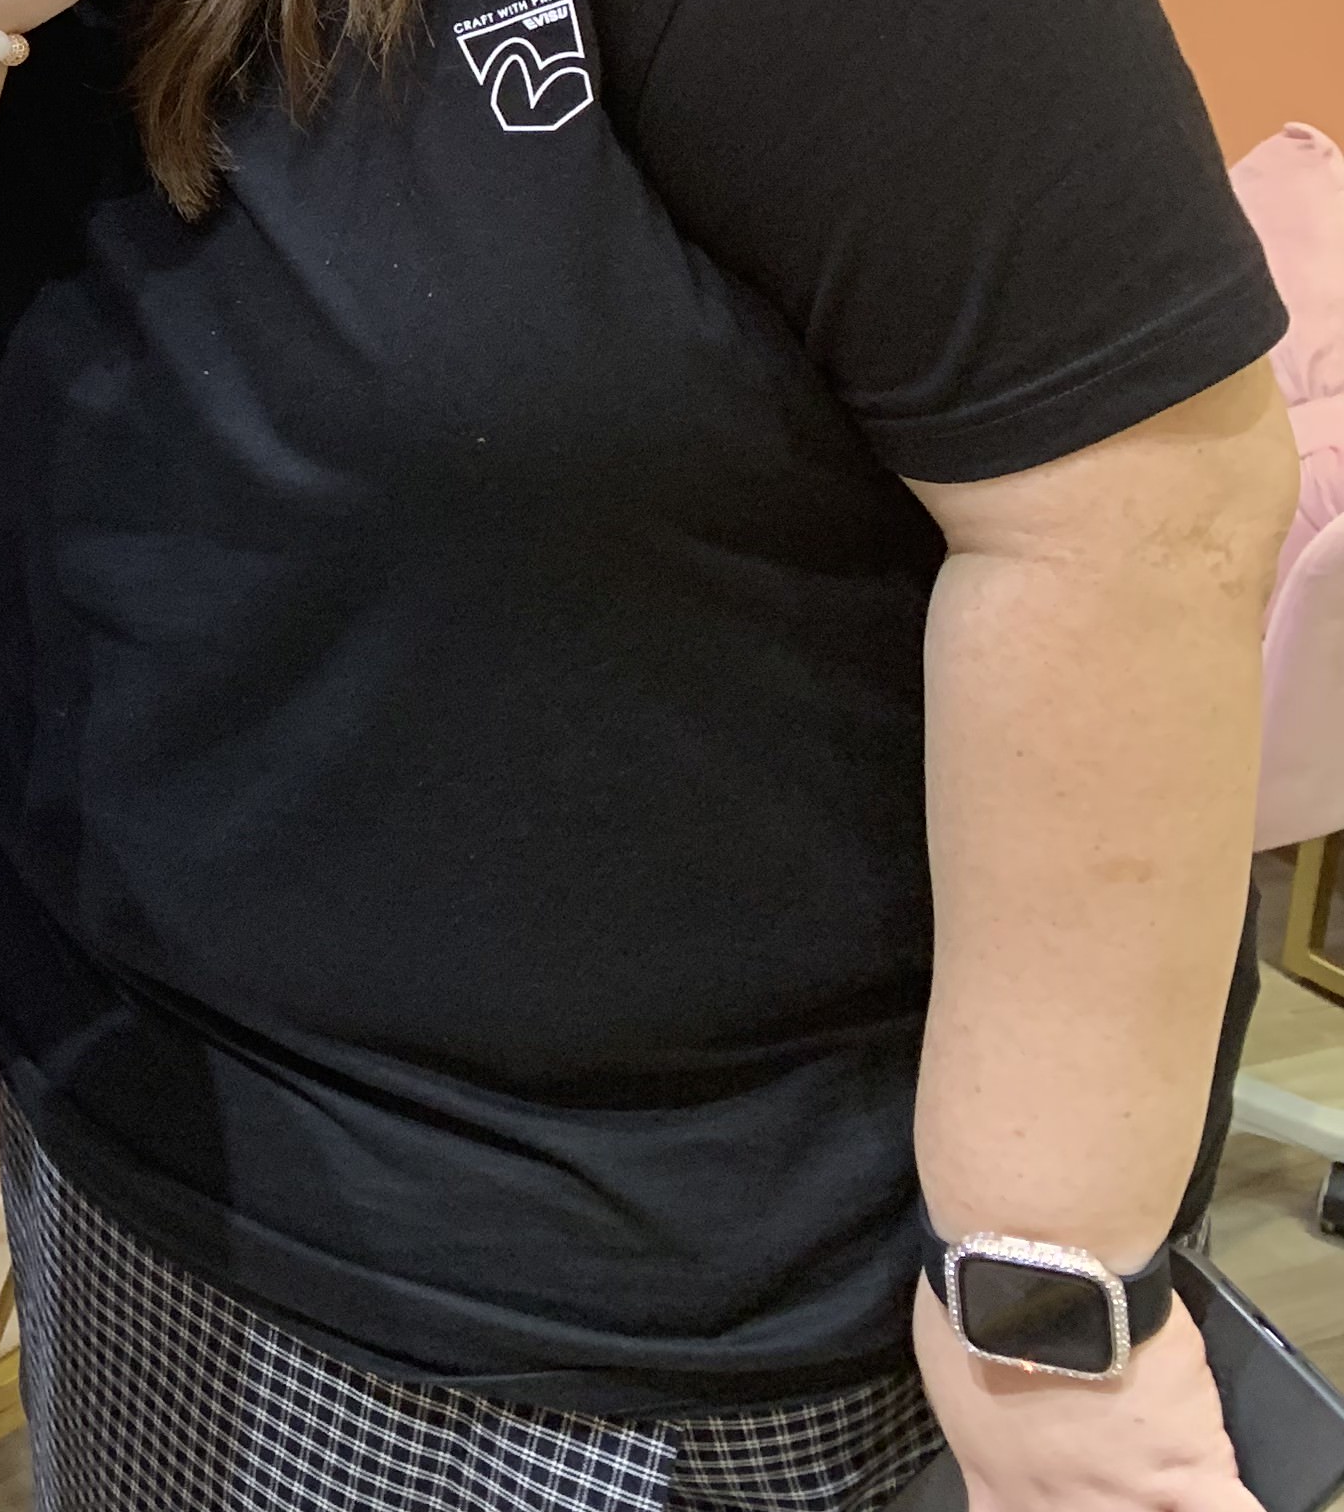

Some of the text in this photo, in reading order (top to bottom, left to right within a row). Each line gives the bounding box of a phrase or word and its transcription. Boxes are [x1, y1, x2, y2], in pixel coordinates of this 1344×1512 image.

[453, 13, 494, 34] CRAFT
[497, 0, 528, 18] WITH
[522, 7, 569, 30] EVISU
